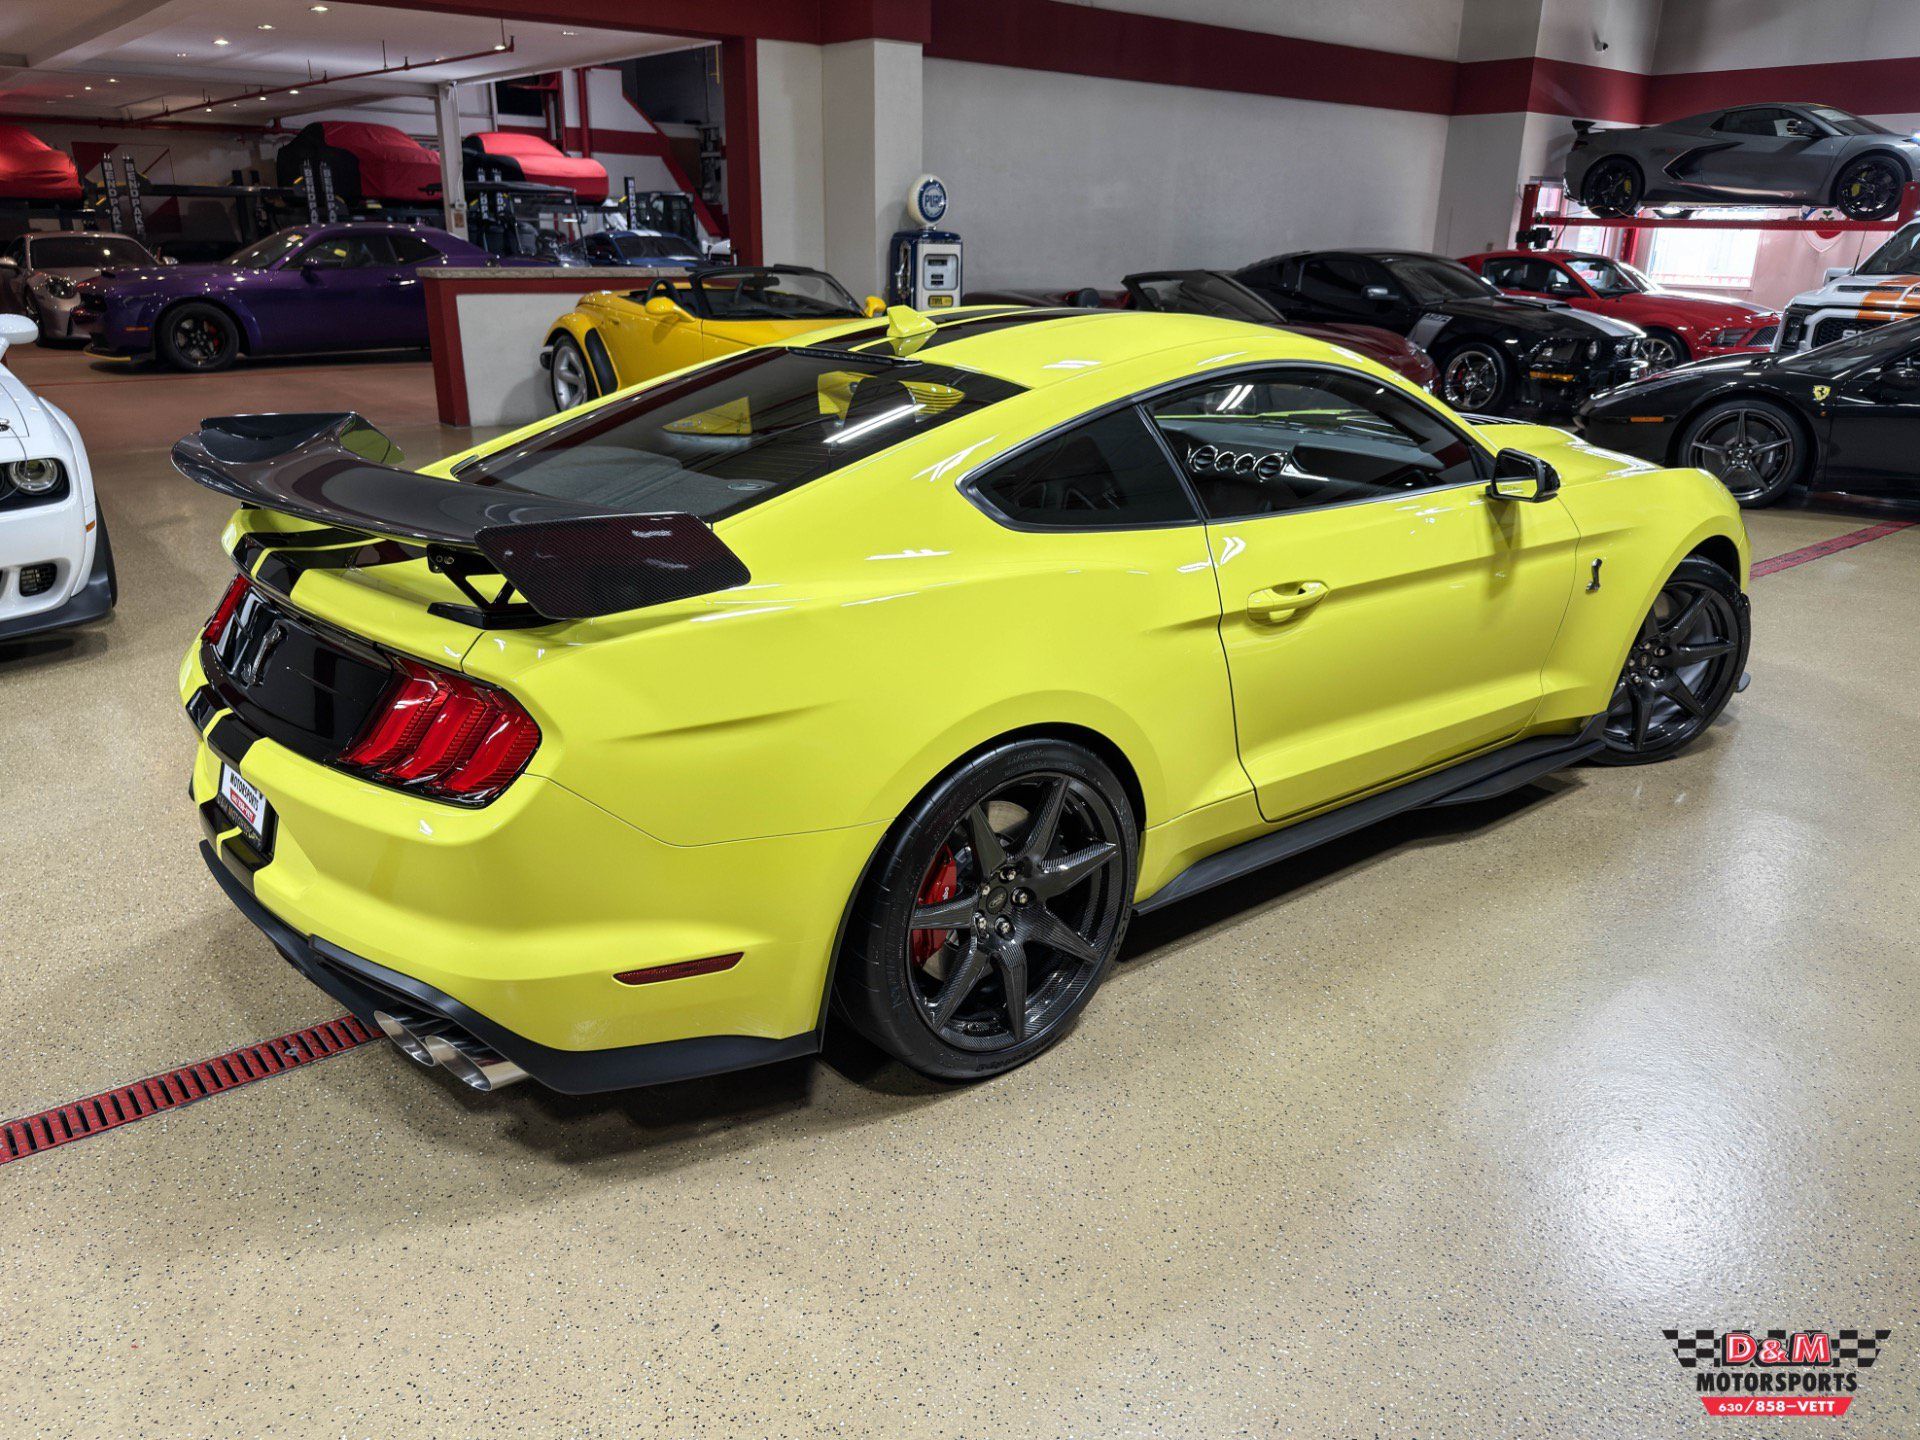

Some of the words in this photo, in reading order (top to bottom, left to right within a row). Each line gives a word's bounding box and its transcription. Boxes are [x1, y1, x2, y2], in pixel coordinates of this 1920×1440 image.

[103, 161, 122, 226] BENDPAK
[125, 162, 144, 227] BENDPAK
[304, 169, 318, 224] BENDPA
[323, 169, 337, 224] BENDPA
[230, 772, 259, 811] MOTORSPORTS
